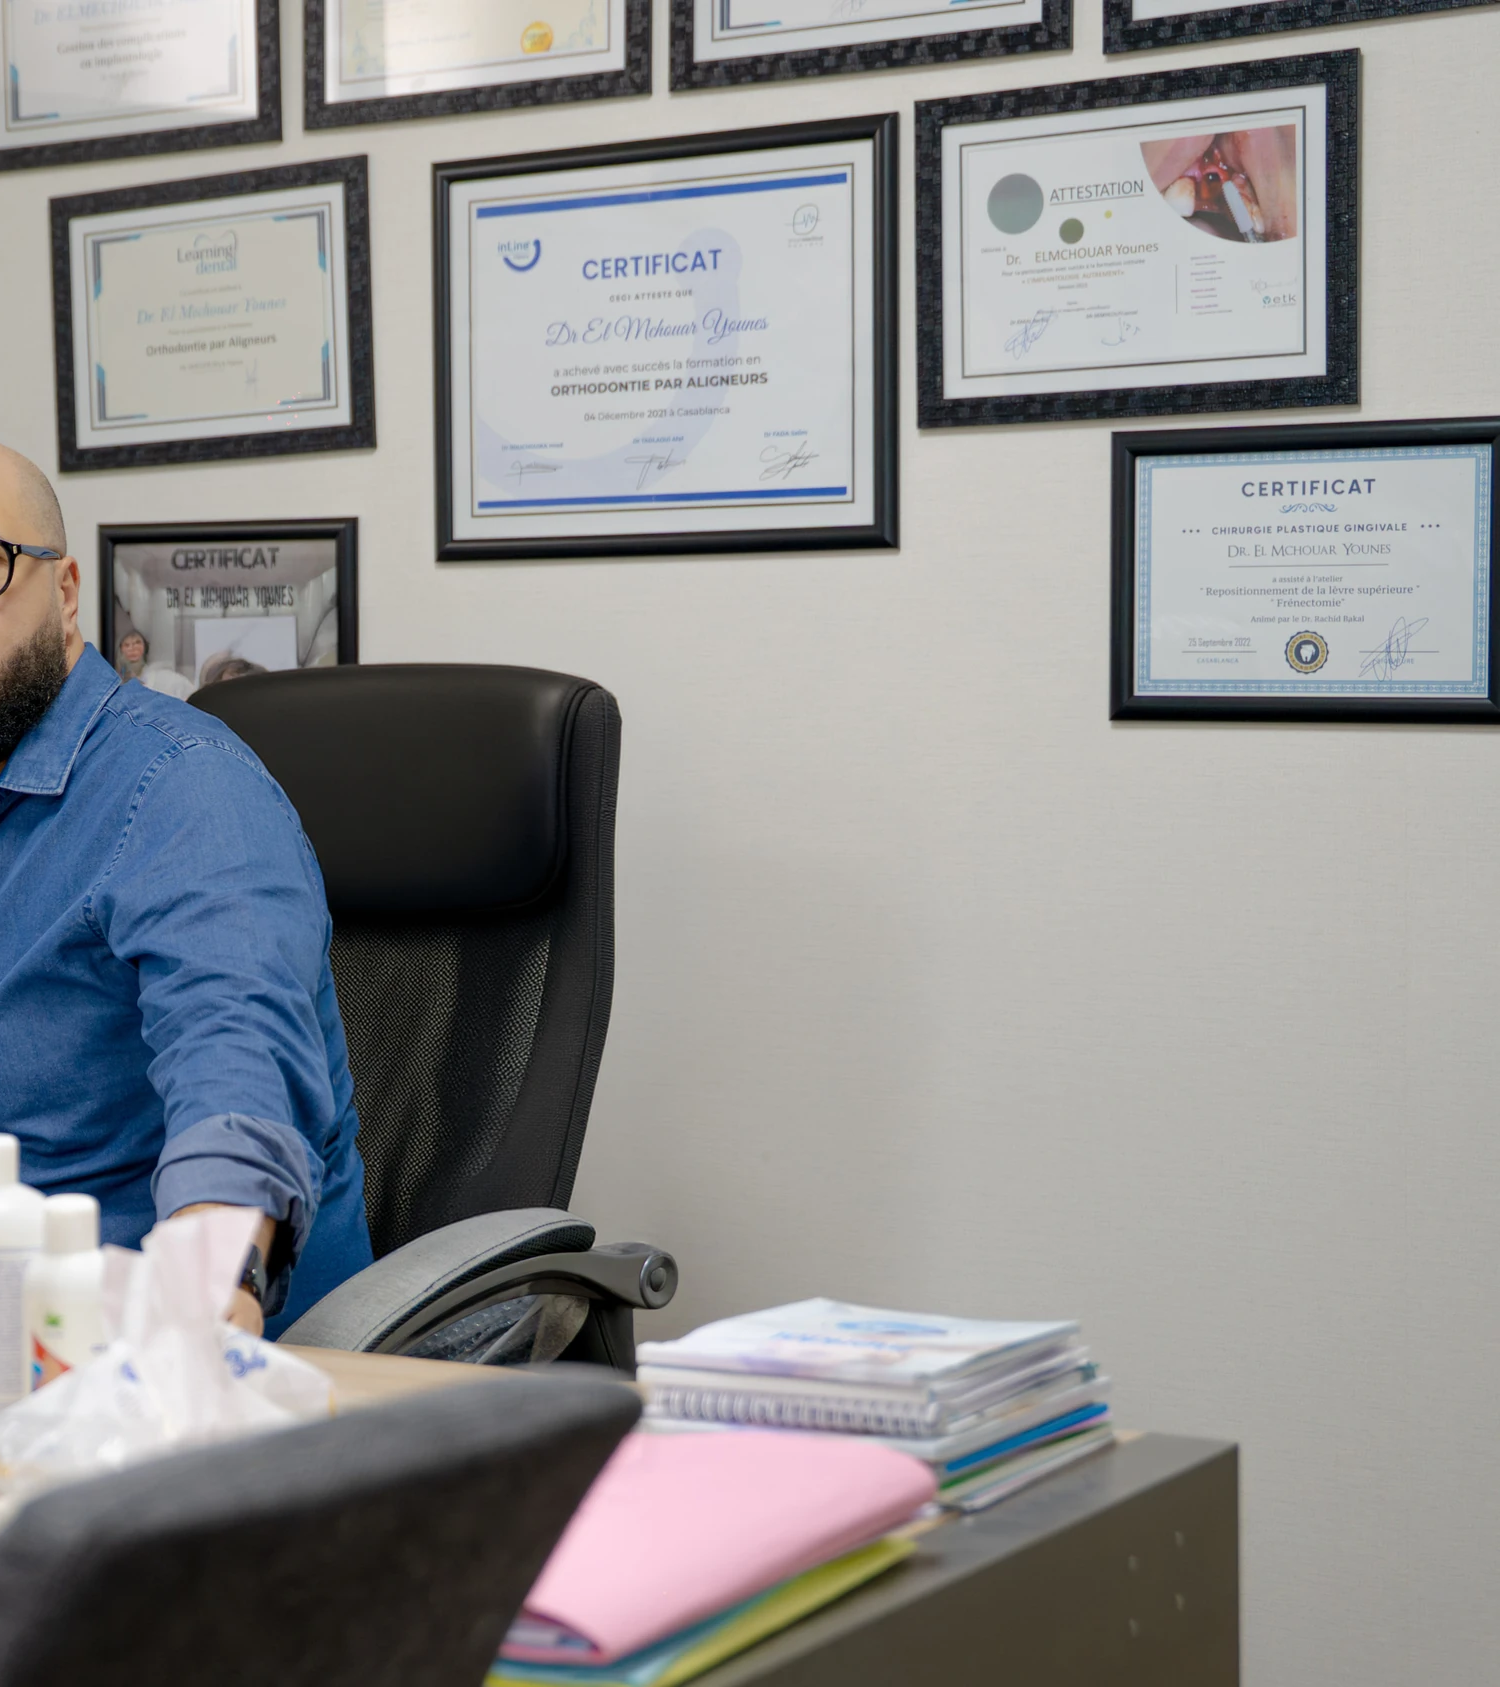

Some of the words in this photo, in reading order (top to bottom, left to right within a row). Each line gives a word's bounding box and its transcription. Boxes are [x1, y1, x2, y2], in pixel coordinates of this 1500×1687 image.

[1049, 180, 1144, 203] ATTESTATION
[177, 243, 234, 264] Learning
[1006, 254, 1022, 266] Dr.
[1035, 245, 1113, 264] ELMCHOUAR
[1116, 242, 1160, 256] Younes
[196, 259, 238, 276] dental
[581, 249, 723, 281] CERTIFICAT
[634, 290, 673, 301] ATTESTE
[675, 289, 694, 298] QUE
[1272, 293, 1297, 304] etk
[545, 321, 579, 347] Dr
[582, 316, 613, 345] El
[614, 314, 698, 342] Mchouar
[702, 307, 771, 346] Younes
[146, 341, 207, 357] Orthodontie
[209, 338, 226, 352] par
[229, 332, 277, 349] Aligneurs
[553, 369, 560, 378] a
[562, 363, 600, 377] achevé
[603, 365, 629, 375] avec
[631, 360, 671, 373] succès
[673, 358, 683, 371] la
[686, 354, 743, 369] formation
[746, 356, 761, 366] en
[551, 379, 651, 397] ORTHODONTIE
[654, 377, 683, 391] PAR
[686, 371, 768, 389] ALIGNEURS
[583, 412, 596, 422] 04
[597, 409, 646, 422] Décembre
[647, 408, 668, 419] 2021
[676, 404, 731, 418] Casablanca
[1241, 478, 1377, 498] CERTIFICAT
[1211, 525, 1273, 536] CHIRURGIE
[1276, 524, 1340, 535] PLASTIQUE
[1344, 522, 1408, 533] GINGIVALE
[171, 547, 280, 571] CERTIFICAT
[1278, 575, 1305, 584] assisté
[1306, 575, 1312, 584] à
[253, 584, 295, 608] YOUNES
[1205, 585, 1299, 597] Repositionnement
[1301, 585, 1314, 596] de
[1316, 585, 1327, 596] la
[1328, 585, 1355, 595] lèvre
[1357, 584, 1414, 597] supérieure
[1250, 615, 1276, 624] Animé
[1277, 617, 1290, 626] par
[1291, 615, 1300, 624] le
[1301, 615, 1313, 624] Dr.
[1314, 615, 1341, 624] Rachid
[1198, 637, 1233, 648] Septembre
[1234, 637, 1252, 647] 2022
